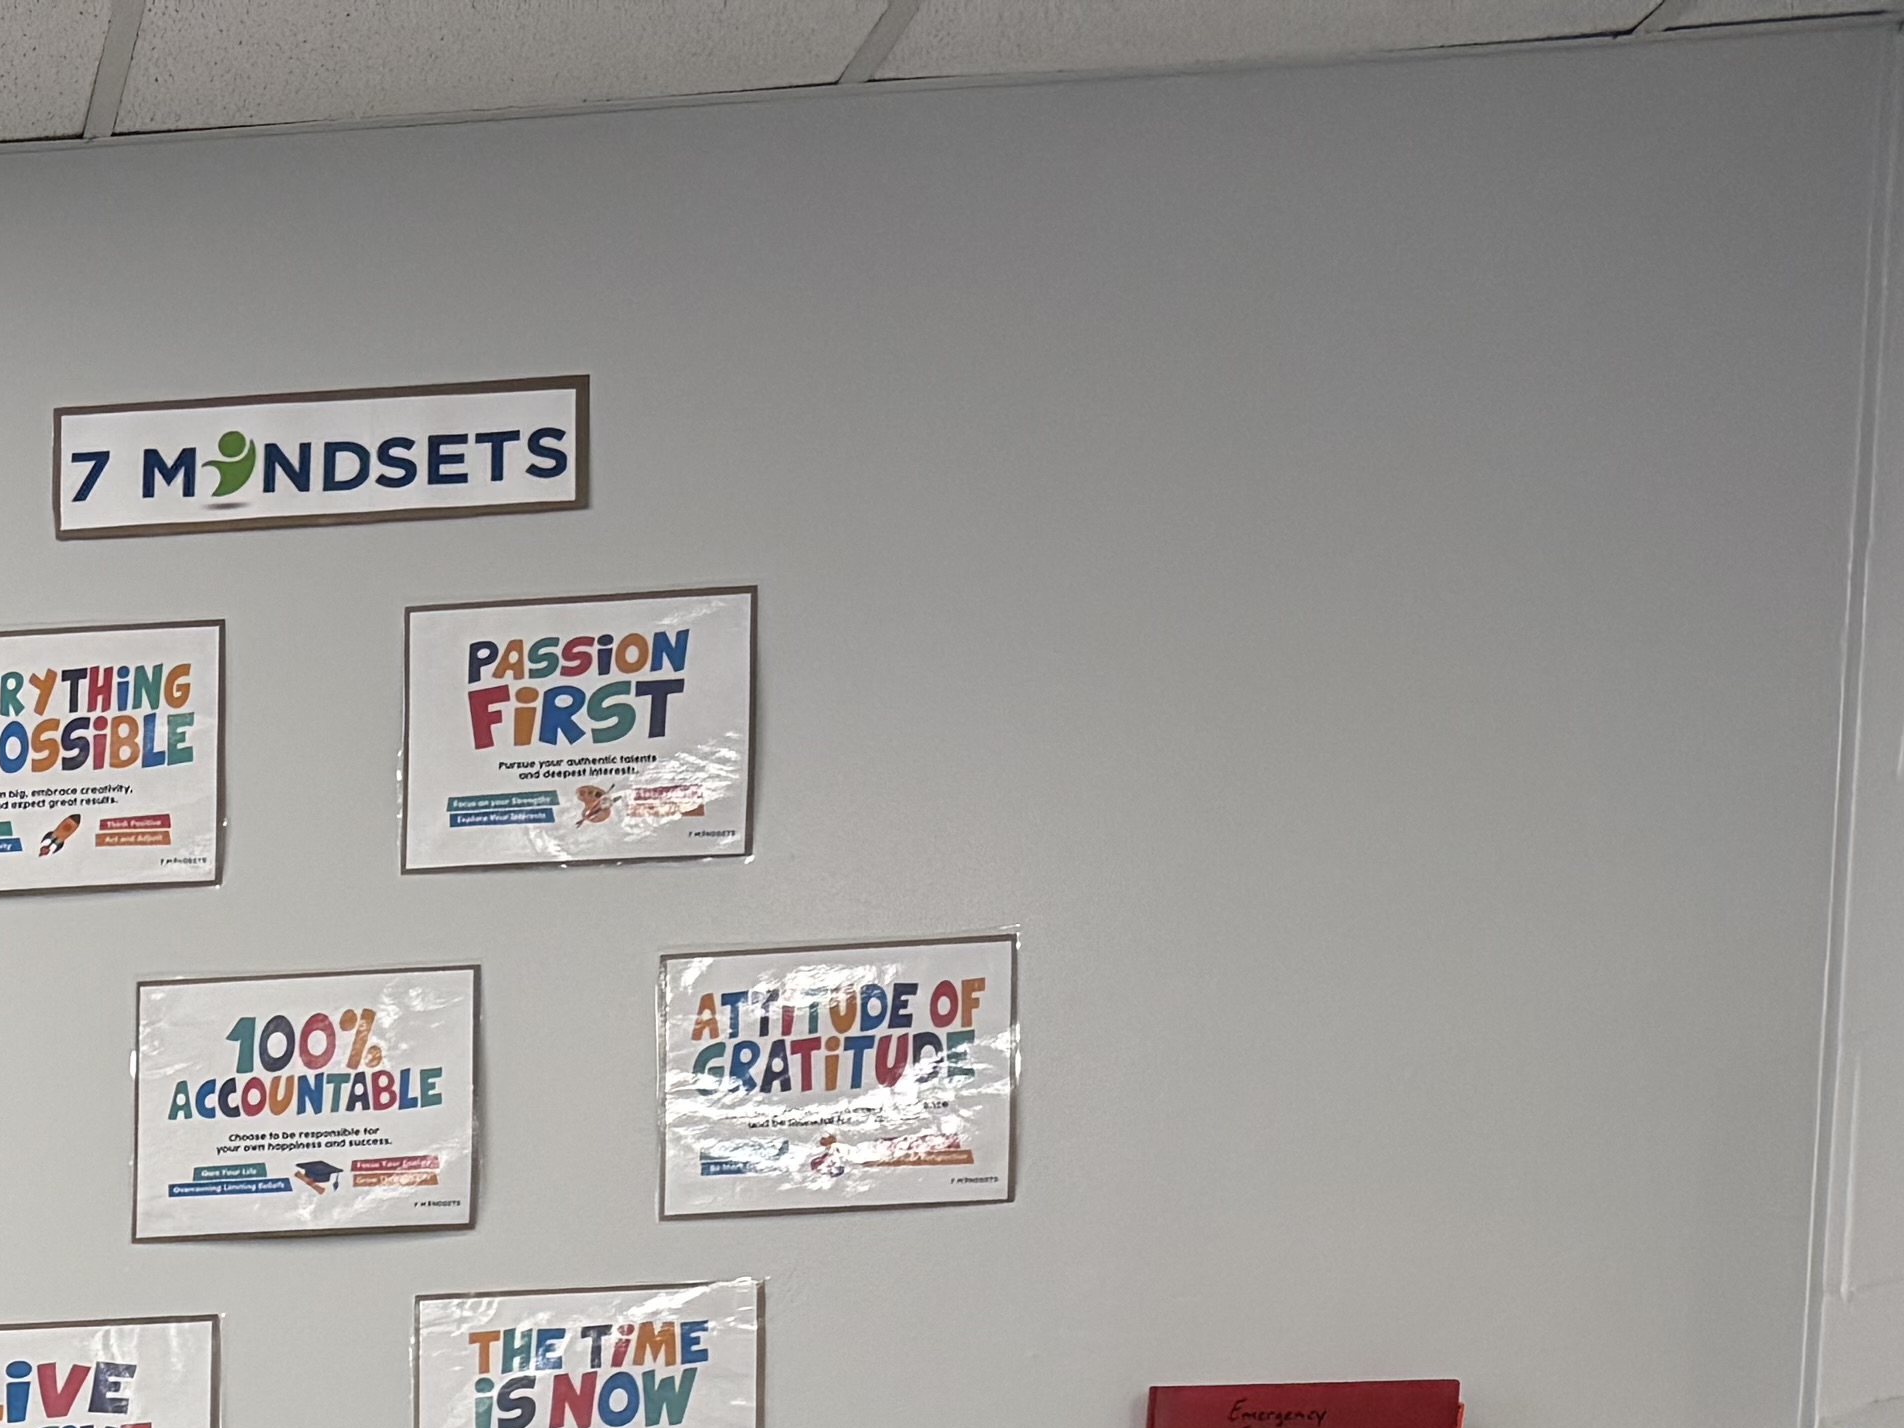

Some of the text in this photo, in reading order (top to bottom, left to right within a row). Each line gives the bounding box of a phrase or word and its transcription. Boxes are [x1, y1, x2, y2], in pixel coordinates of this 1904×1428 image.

[70, 450, 111, 503] 7
[467, 628, 690, 684] PASSION
[467, 678, 685, 750] FIRST
[929, 977, 986, 1028] OF
[225, 1008, 384, 1074] 100%
[692, 1029, 976, 1096] GRATITUDE
[167, 1066, 443, 1120] ACCOUNTABLE
[468, 1327, 566, 1375] THE
[1228, 1399, 1327, 1428] Emergency
